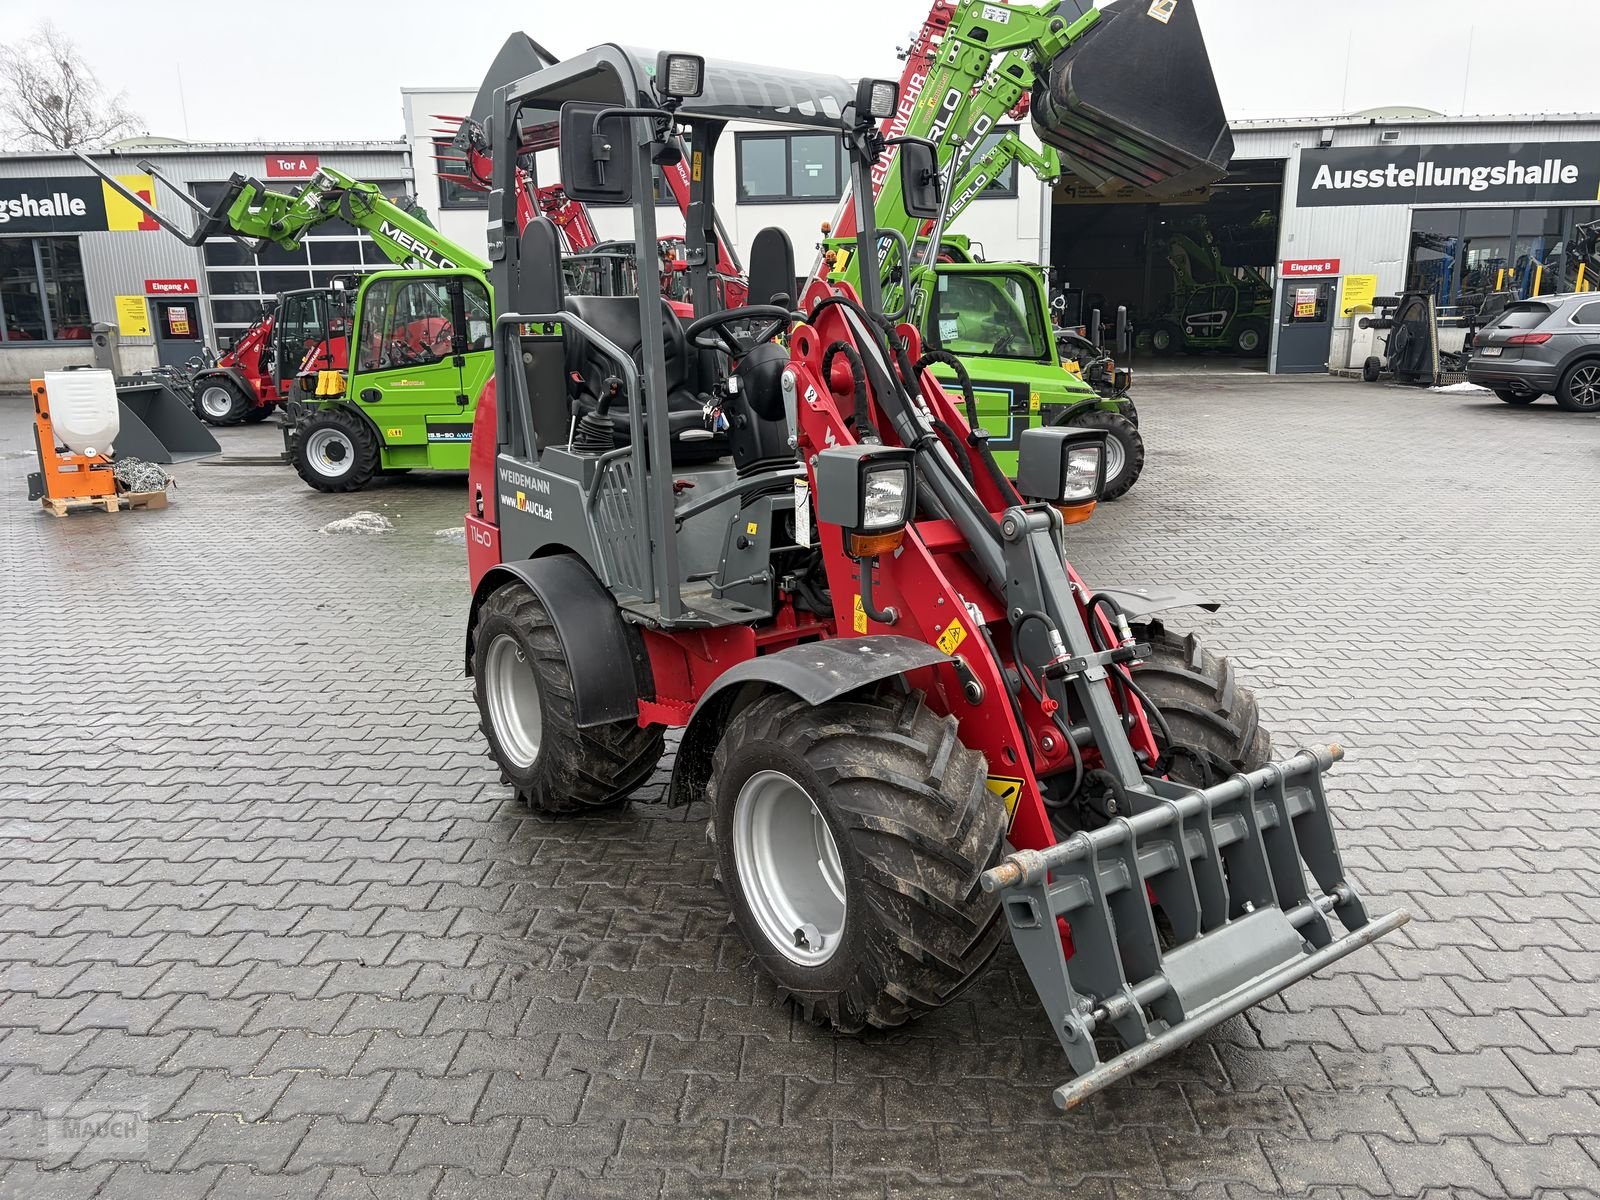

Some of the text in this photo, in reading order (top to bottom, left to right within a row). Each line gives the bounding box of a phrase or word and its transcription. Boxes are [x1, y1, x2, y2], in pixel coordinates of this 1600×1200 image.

[928, 88, 962, 143] RLO
[276, 160, 307, 170] Tor A
[1311, 158, 1579, 191] Ausstellungshalle
[945, 173, 988, 221] MERLO
[379, 220, 457, 270] MERLO
[1290, 262, 1331, 272] Eingang B
[152, 282, 190, 291] Eingang A
[499, 468, 551, 495] WEIDEMANN
[500, 493, 553, 521] www.MAUCH.at
[470, 525, 492, 548] 1160
